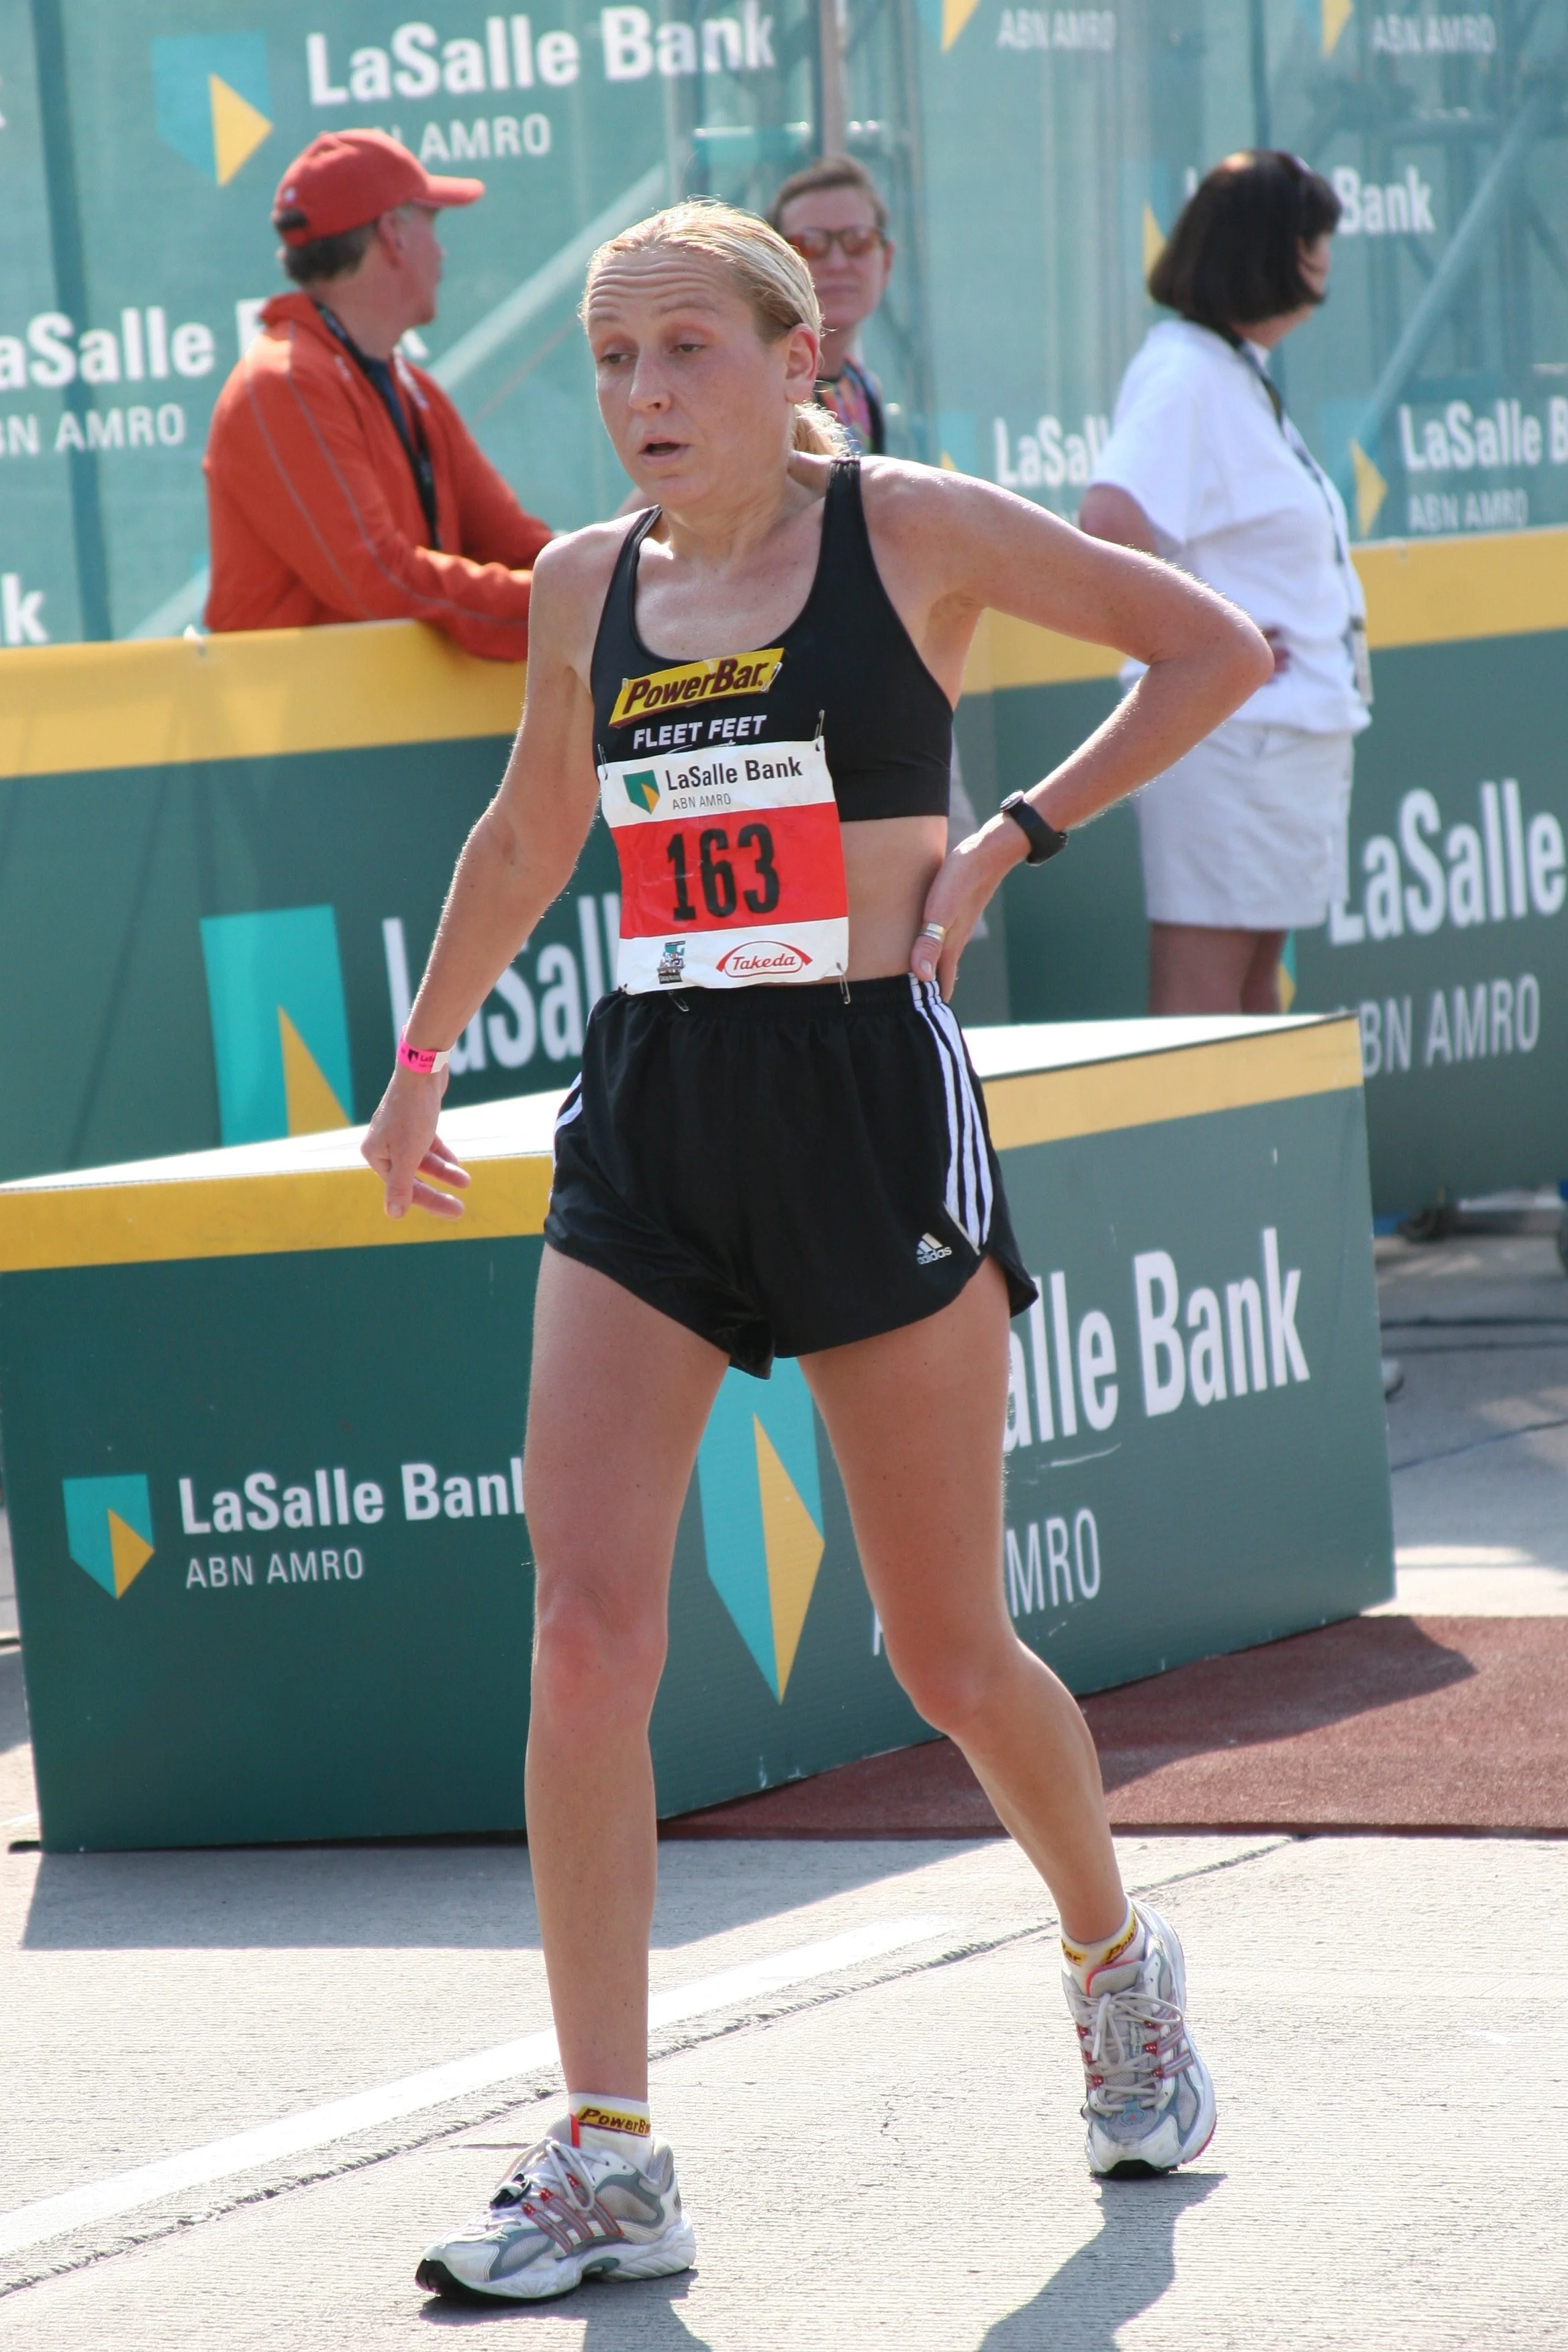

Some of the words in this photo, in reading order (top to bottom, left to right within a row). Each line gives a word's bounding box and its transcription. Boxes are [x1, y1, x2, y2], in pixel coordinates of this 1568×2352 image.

[306, 13, 579, 105] LaSalle
[601, 0, 775, 81] Bank
[420, 113, 550, 163] AMRO
[1333, 165, 1435, 234] Bank
[0, 305, 215, 389] aSalle
[54, 403, 186, 453] AMRO
[994, 414, 1108, 487] LaSal
[1400, 398, 1542, 471] LaSalle
[633, 722, 703, 750] FLEET
[707, 715, 767, 739] FEET
[665, 763, 738, 791] LaSalle
[744, 756, 803, 781] Bank
[673, 796, 696, 810] ABN
[699, 793, 732, 807] AMRO
[667, 823, 780, 921] 163
[382, 891, 622, 1075] LSall
[732, 953, 796, 971] Takeda
[1359, 996, 1411, 1077] BN
[1426, 974, 1541, 1067] AMRO
[917, 1246, 952, 1265] adidas
[1003, 1271, 1118, 1452] alle
[1134, 1226, 1310, 1418] Bank
[179, 1468, 384, 1535] LaSalle
[186, 1555, 254, 1589] ABN
[266, 1548, 364, 1585] AMRO
[1006, 1508, 1101, 1618] MRO
[579, 2108, 650, 2135] PowerB
